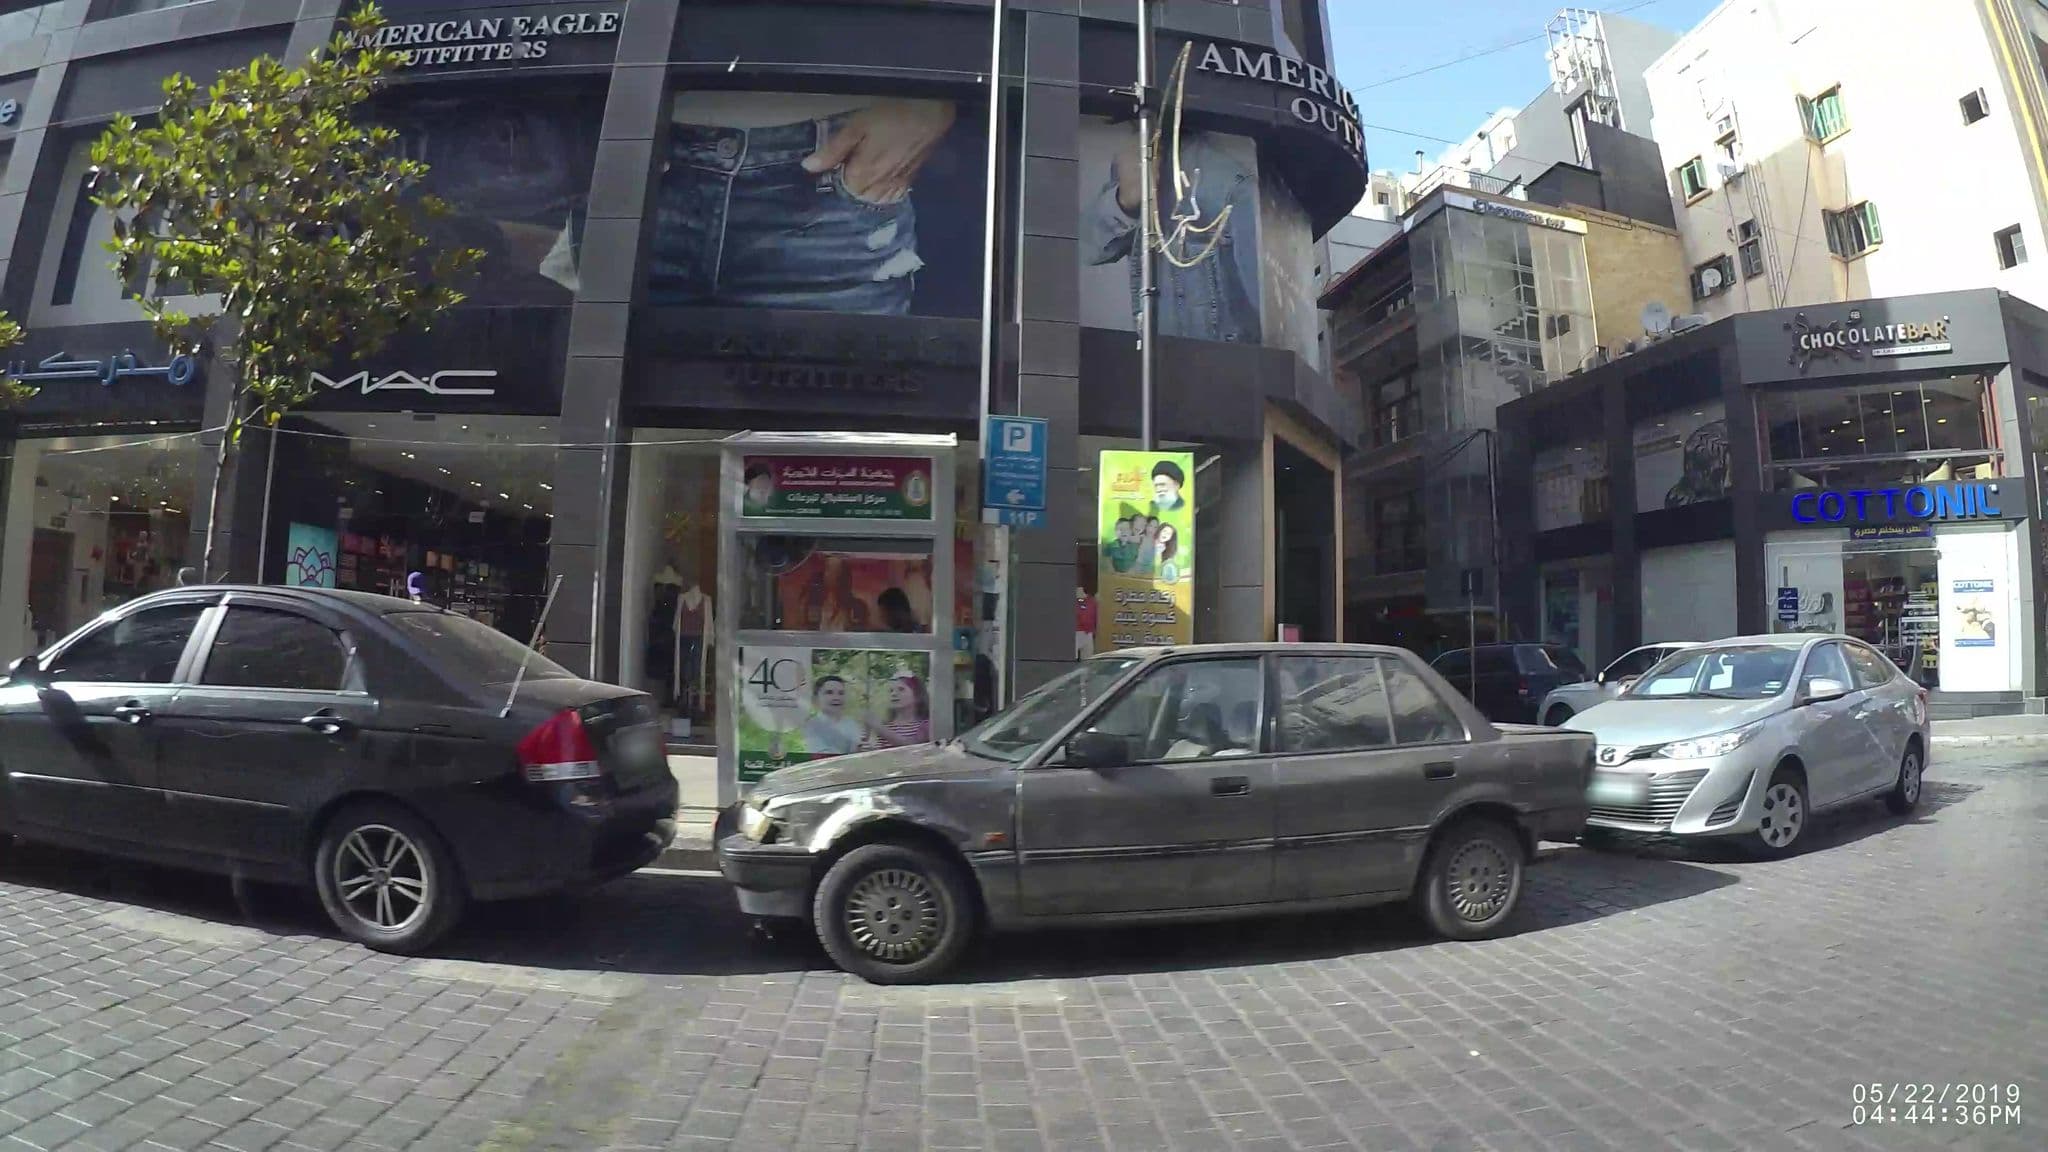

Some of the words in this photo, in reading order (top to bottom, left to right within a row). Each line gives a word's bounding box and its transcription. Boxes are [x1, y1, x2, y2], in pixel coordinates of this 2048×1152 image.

[508, 12, 619, 37] EAGLE
[1009, 427, 1026, 447] P
[1791, 484, 2001, 523] COTTONIL
[748, 657, 803, 694] 40
